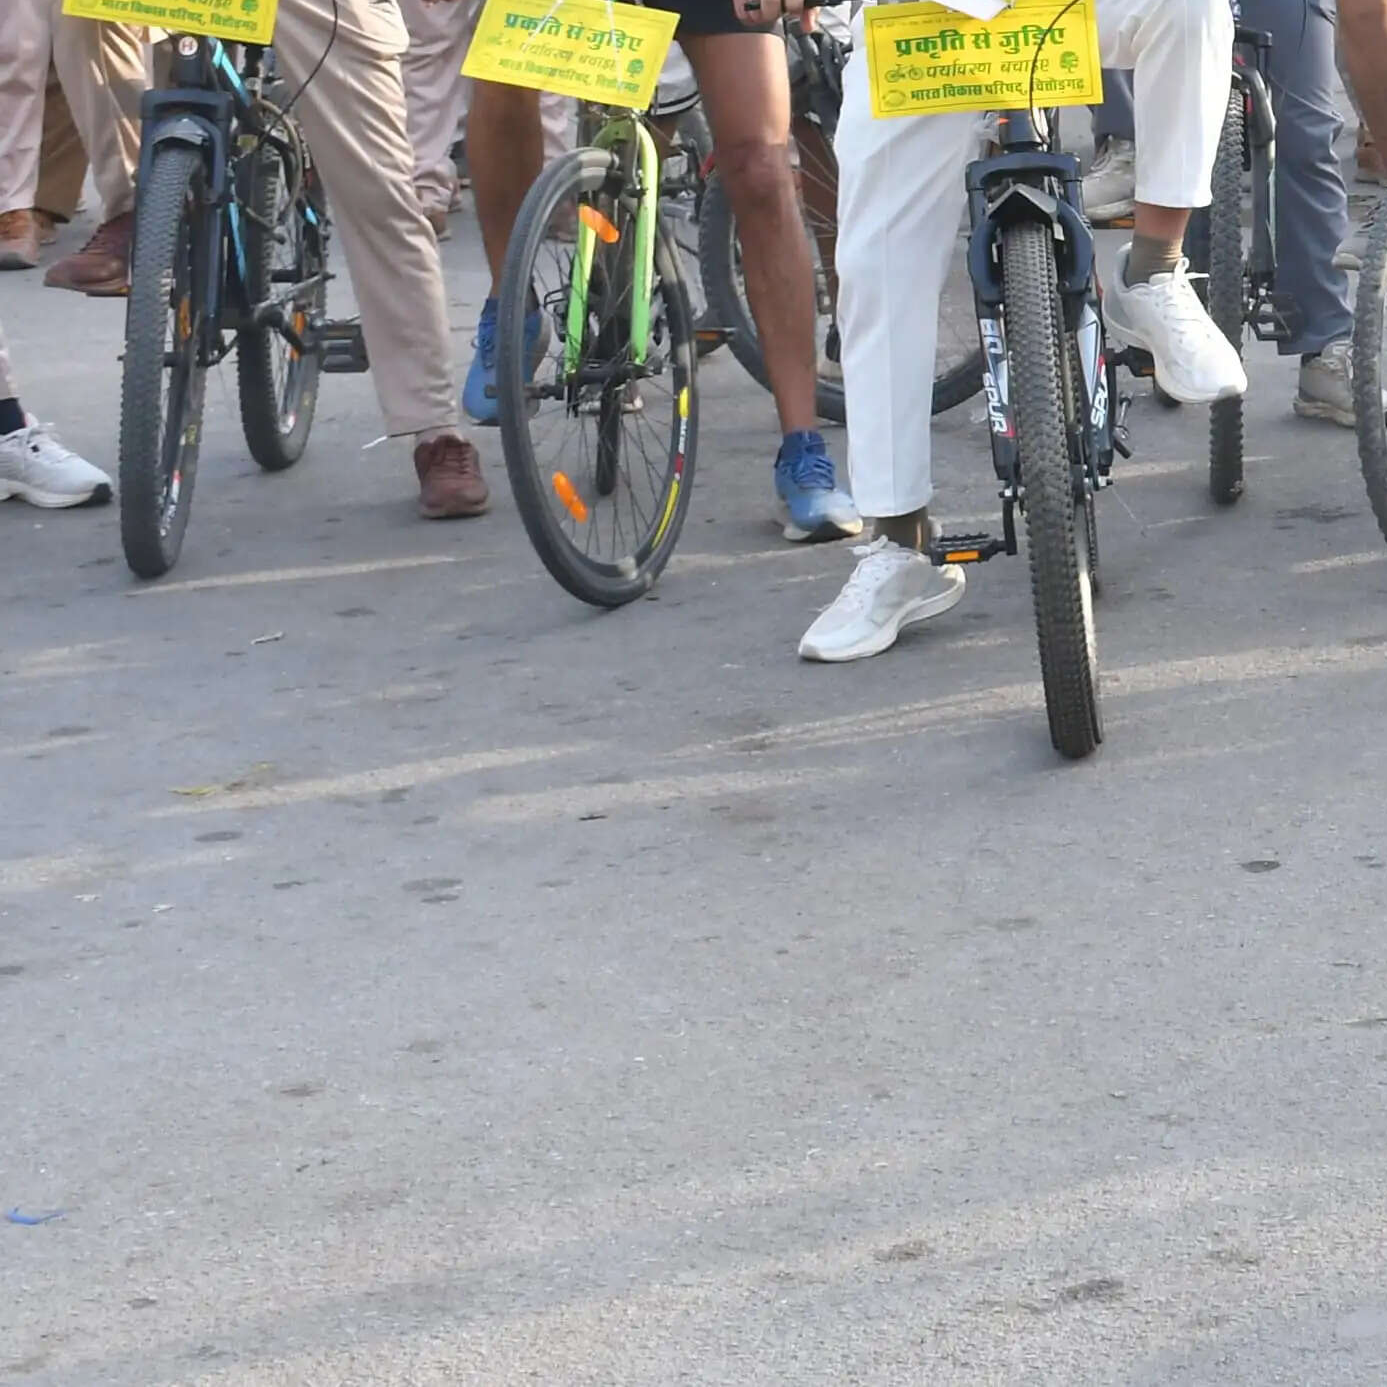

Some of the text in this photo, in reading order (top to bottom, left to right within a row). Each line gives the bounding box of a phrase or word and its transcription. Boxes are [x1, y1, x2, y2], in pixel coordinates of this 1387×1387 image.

[504, 12, 643, 52] प्रकृति से जुड़िए
[894, 24, 1065, 58] प्रकृति से जुड़िए
[983, 372, 1008, 433] SPUR
